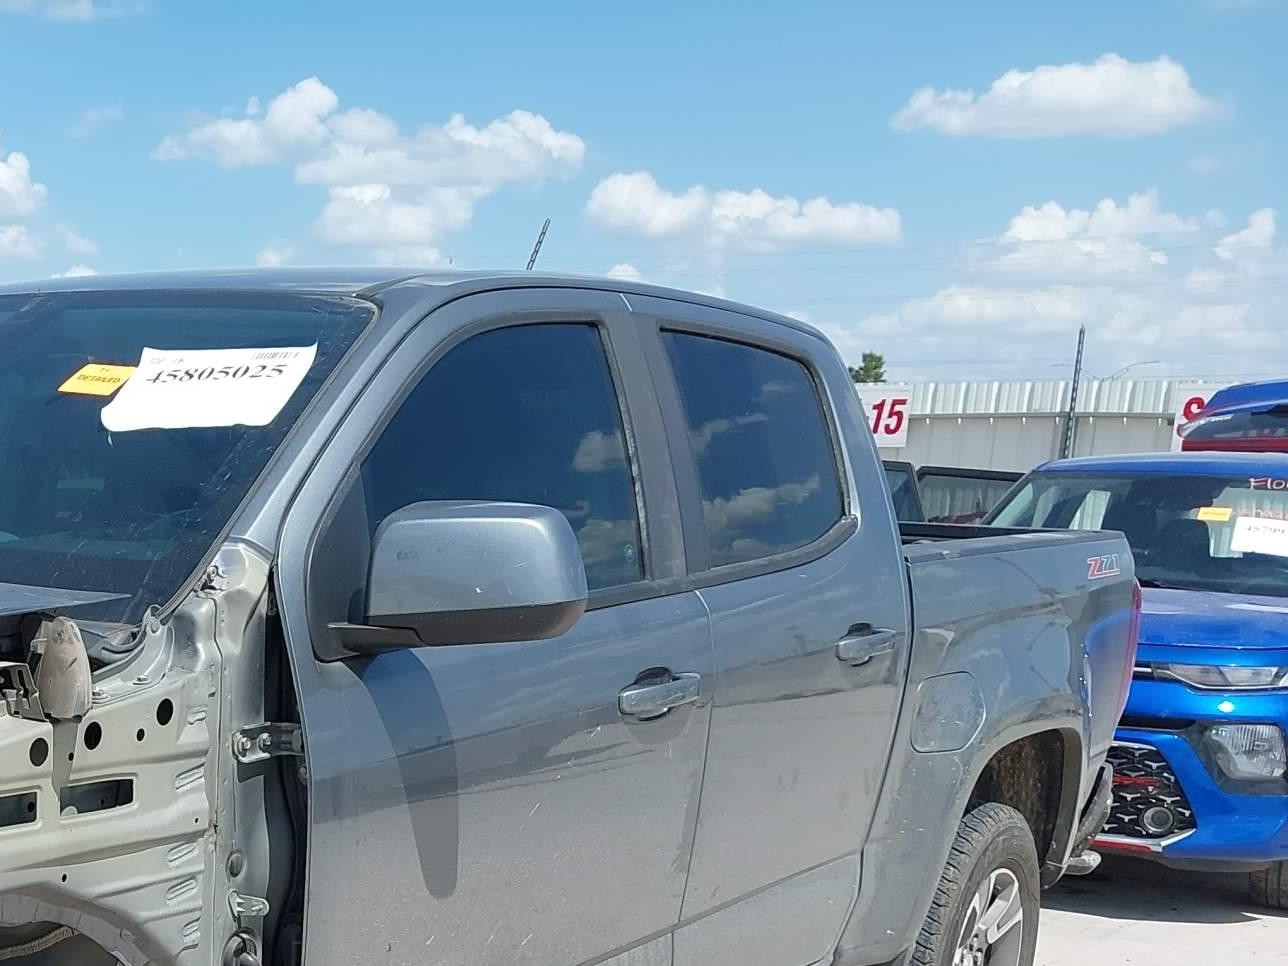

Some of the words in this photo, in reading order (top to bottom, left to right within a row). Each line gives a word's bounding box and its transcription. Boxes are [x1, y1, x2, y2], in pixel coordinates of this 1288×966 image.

[77, 373, 121, 384] DETAILED
[145, 364, 289, 385] 45805025
[1086, 553, 1121, 580] Z71
